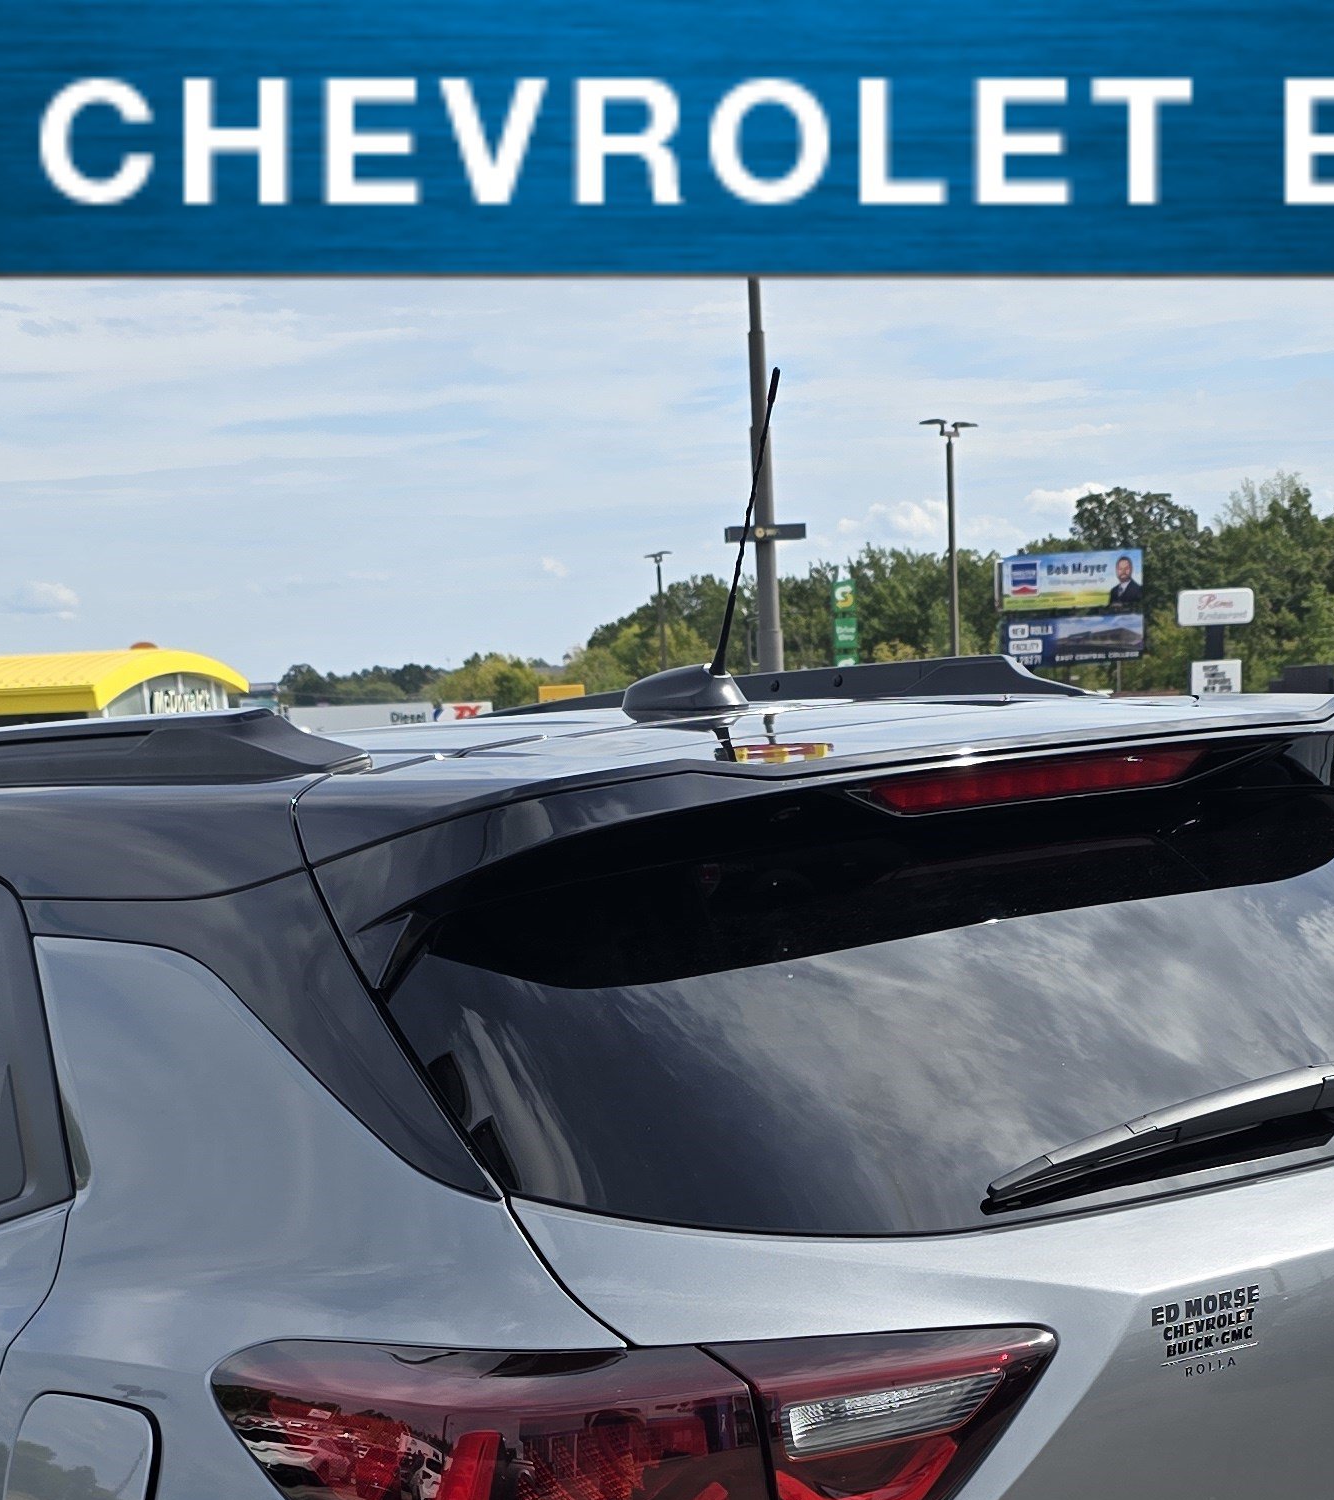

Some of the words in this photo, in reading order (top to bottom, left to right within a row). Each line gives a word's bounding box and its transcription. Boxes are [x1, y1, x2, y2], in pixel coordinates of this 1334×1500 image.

[1046, 563, 1069, 576] Bob
[1072, 562, 1107, 577] Mayer
[390, 712, 427, 724] Diesel
[1150, 1302, 1181, 1328] ED
[1184, 1284, 1261, 1320] MORSE
[1162, 1307, 1256, 1342] CHEVROLET
[1184, 1356, 1237, 1378] ROLLA
